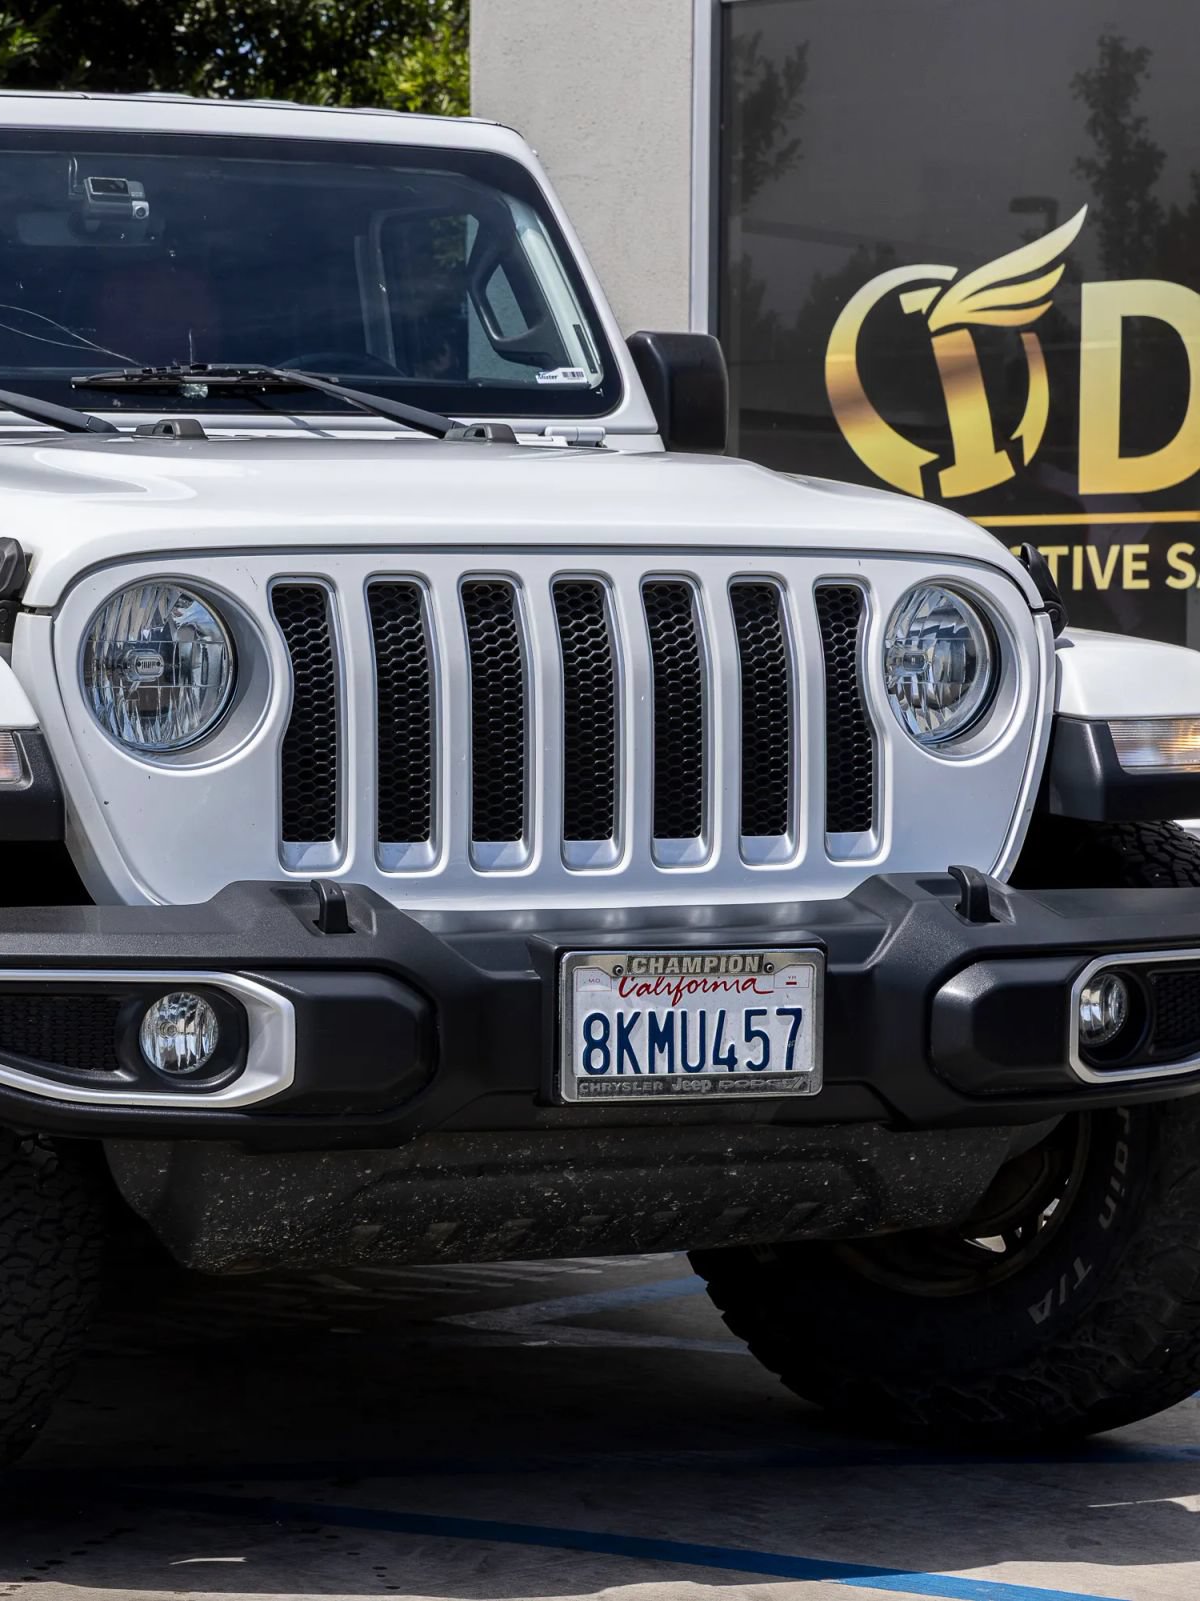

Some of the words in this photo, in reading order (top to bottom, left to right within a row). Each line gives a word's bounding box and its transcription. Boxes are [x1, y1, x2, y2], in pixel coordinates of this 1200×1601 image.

[631, 955, 761, 974] CHAMPION
[618, 976, 775, 1007] California
[582, 1007, 803, 1076] 8KMU457
[578, 1080, 664, 1094] CHRYSLER
[671, 1077, 712, 1092] Jeep
